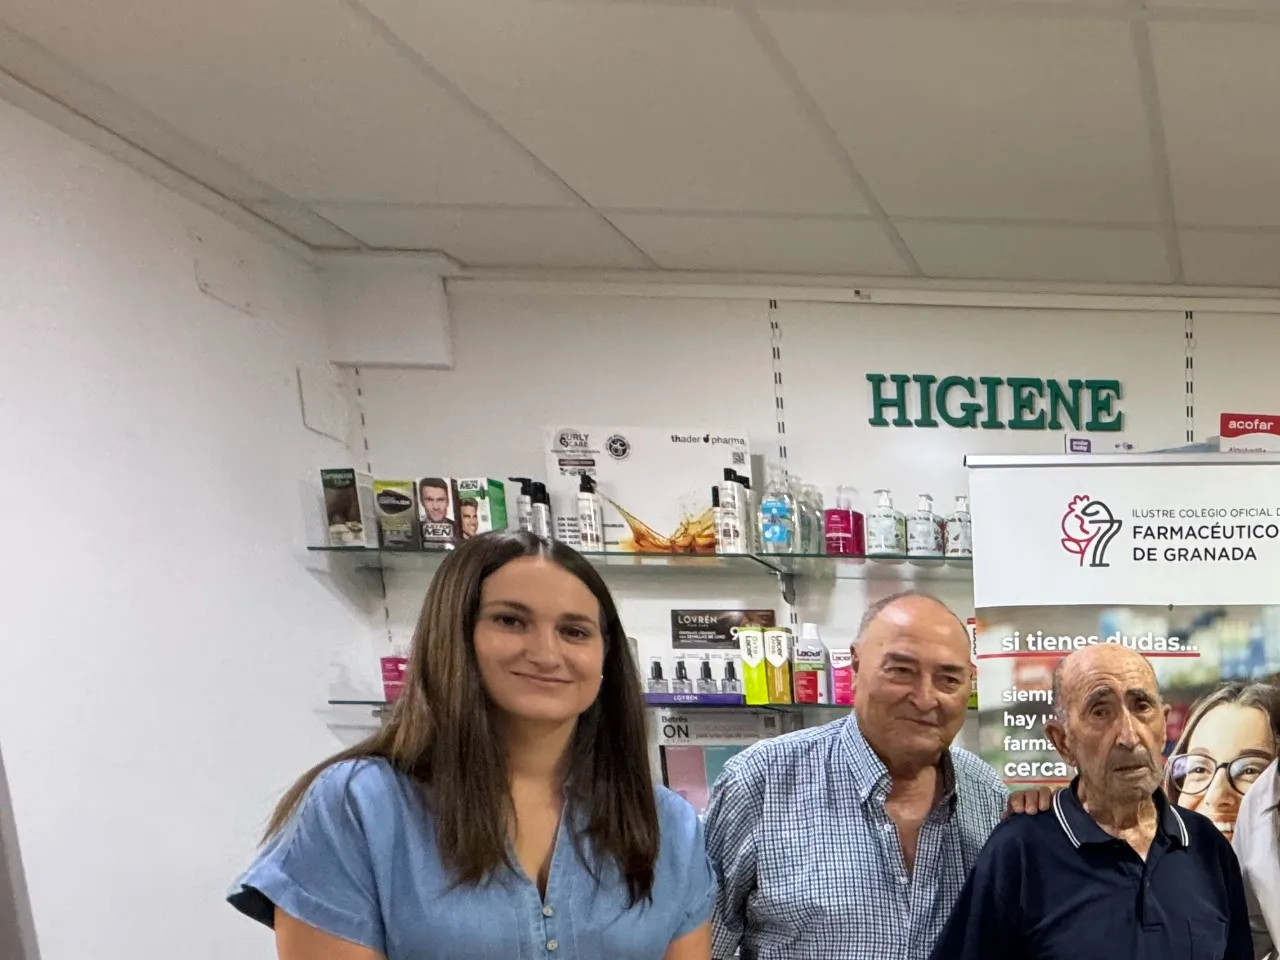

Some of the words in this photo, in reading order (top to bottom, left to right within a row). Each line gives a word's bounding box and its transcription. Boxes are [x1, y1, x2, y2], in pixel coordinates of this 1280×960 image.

[866, 373, 1125, 432] HIGIENE
[1229, 419, 1274, 430] acofar
[671, 434, 701, 444] thader
[711, 436, 745, 446] pharma
[460, 482, 478, 490] MEN
[1132, 508, 1176, 519] ILUSTRE
[1178, 508, 1228, 518] COLEGIO
[1230, 507, 1273, 517] OFICIAL
[424, 528, 452, 537] MEN
[1132, 547, 1158, 562] DE
[1163, 546, 1258, 562] GRANADA
[1001, 632, 1020, 652] si
[1026, 633, 1099, 652] tienes
[796, 649, 822, 657] Lacer
[1003, 711, 1037, 730] hay
[663, 724, 690, 738] ON
[1004, 761, 1068, 777] cerca
